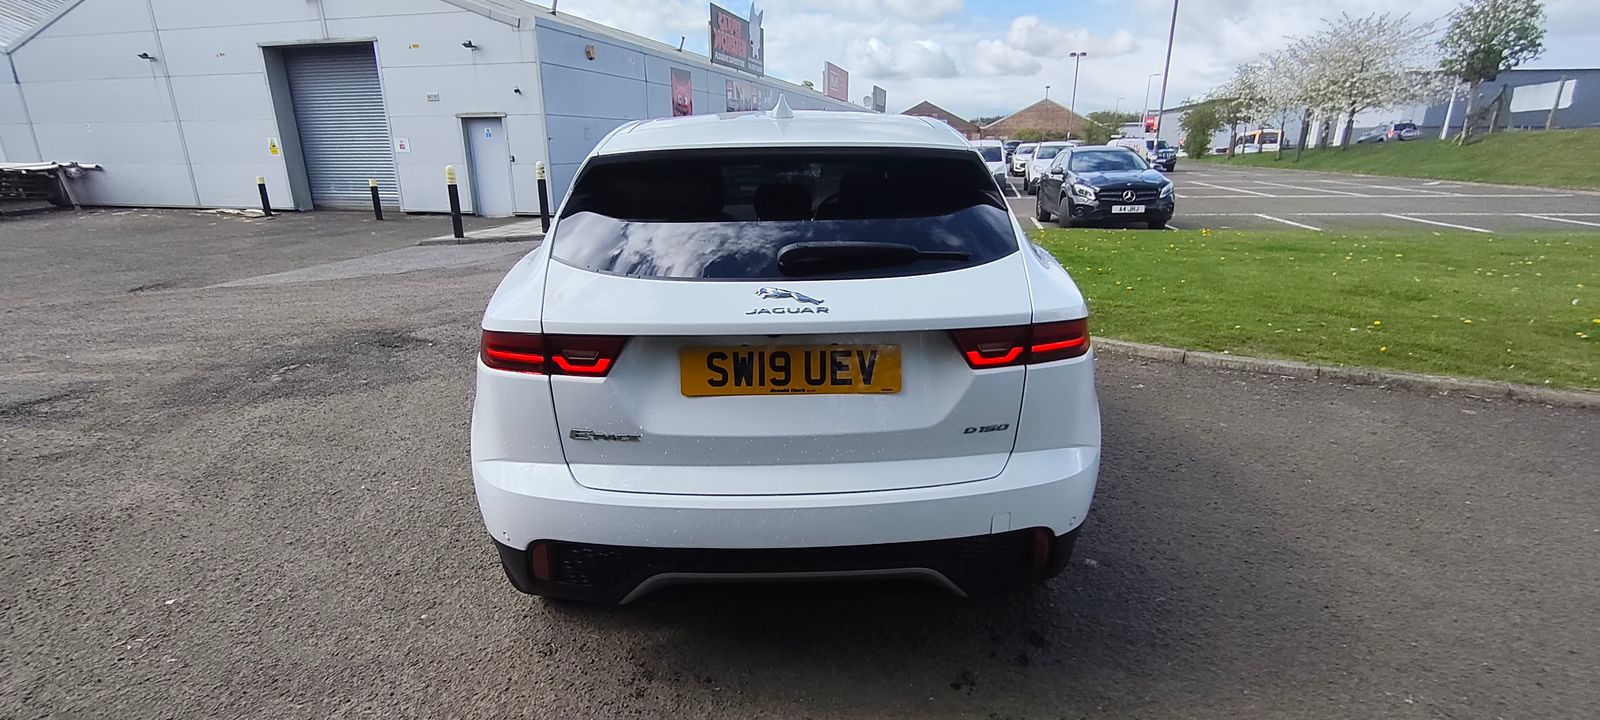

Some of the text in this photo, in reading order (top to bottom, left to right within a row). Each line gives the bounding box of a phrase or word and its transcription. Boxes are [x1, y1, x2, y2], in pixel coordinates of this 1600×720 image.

[745, 307, 829, 315] JAGUAR
[706, 350, 877, 387] SW19 UEV
